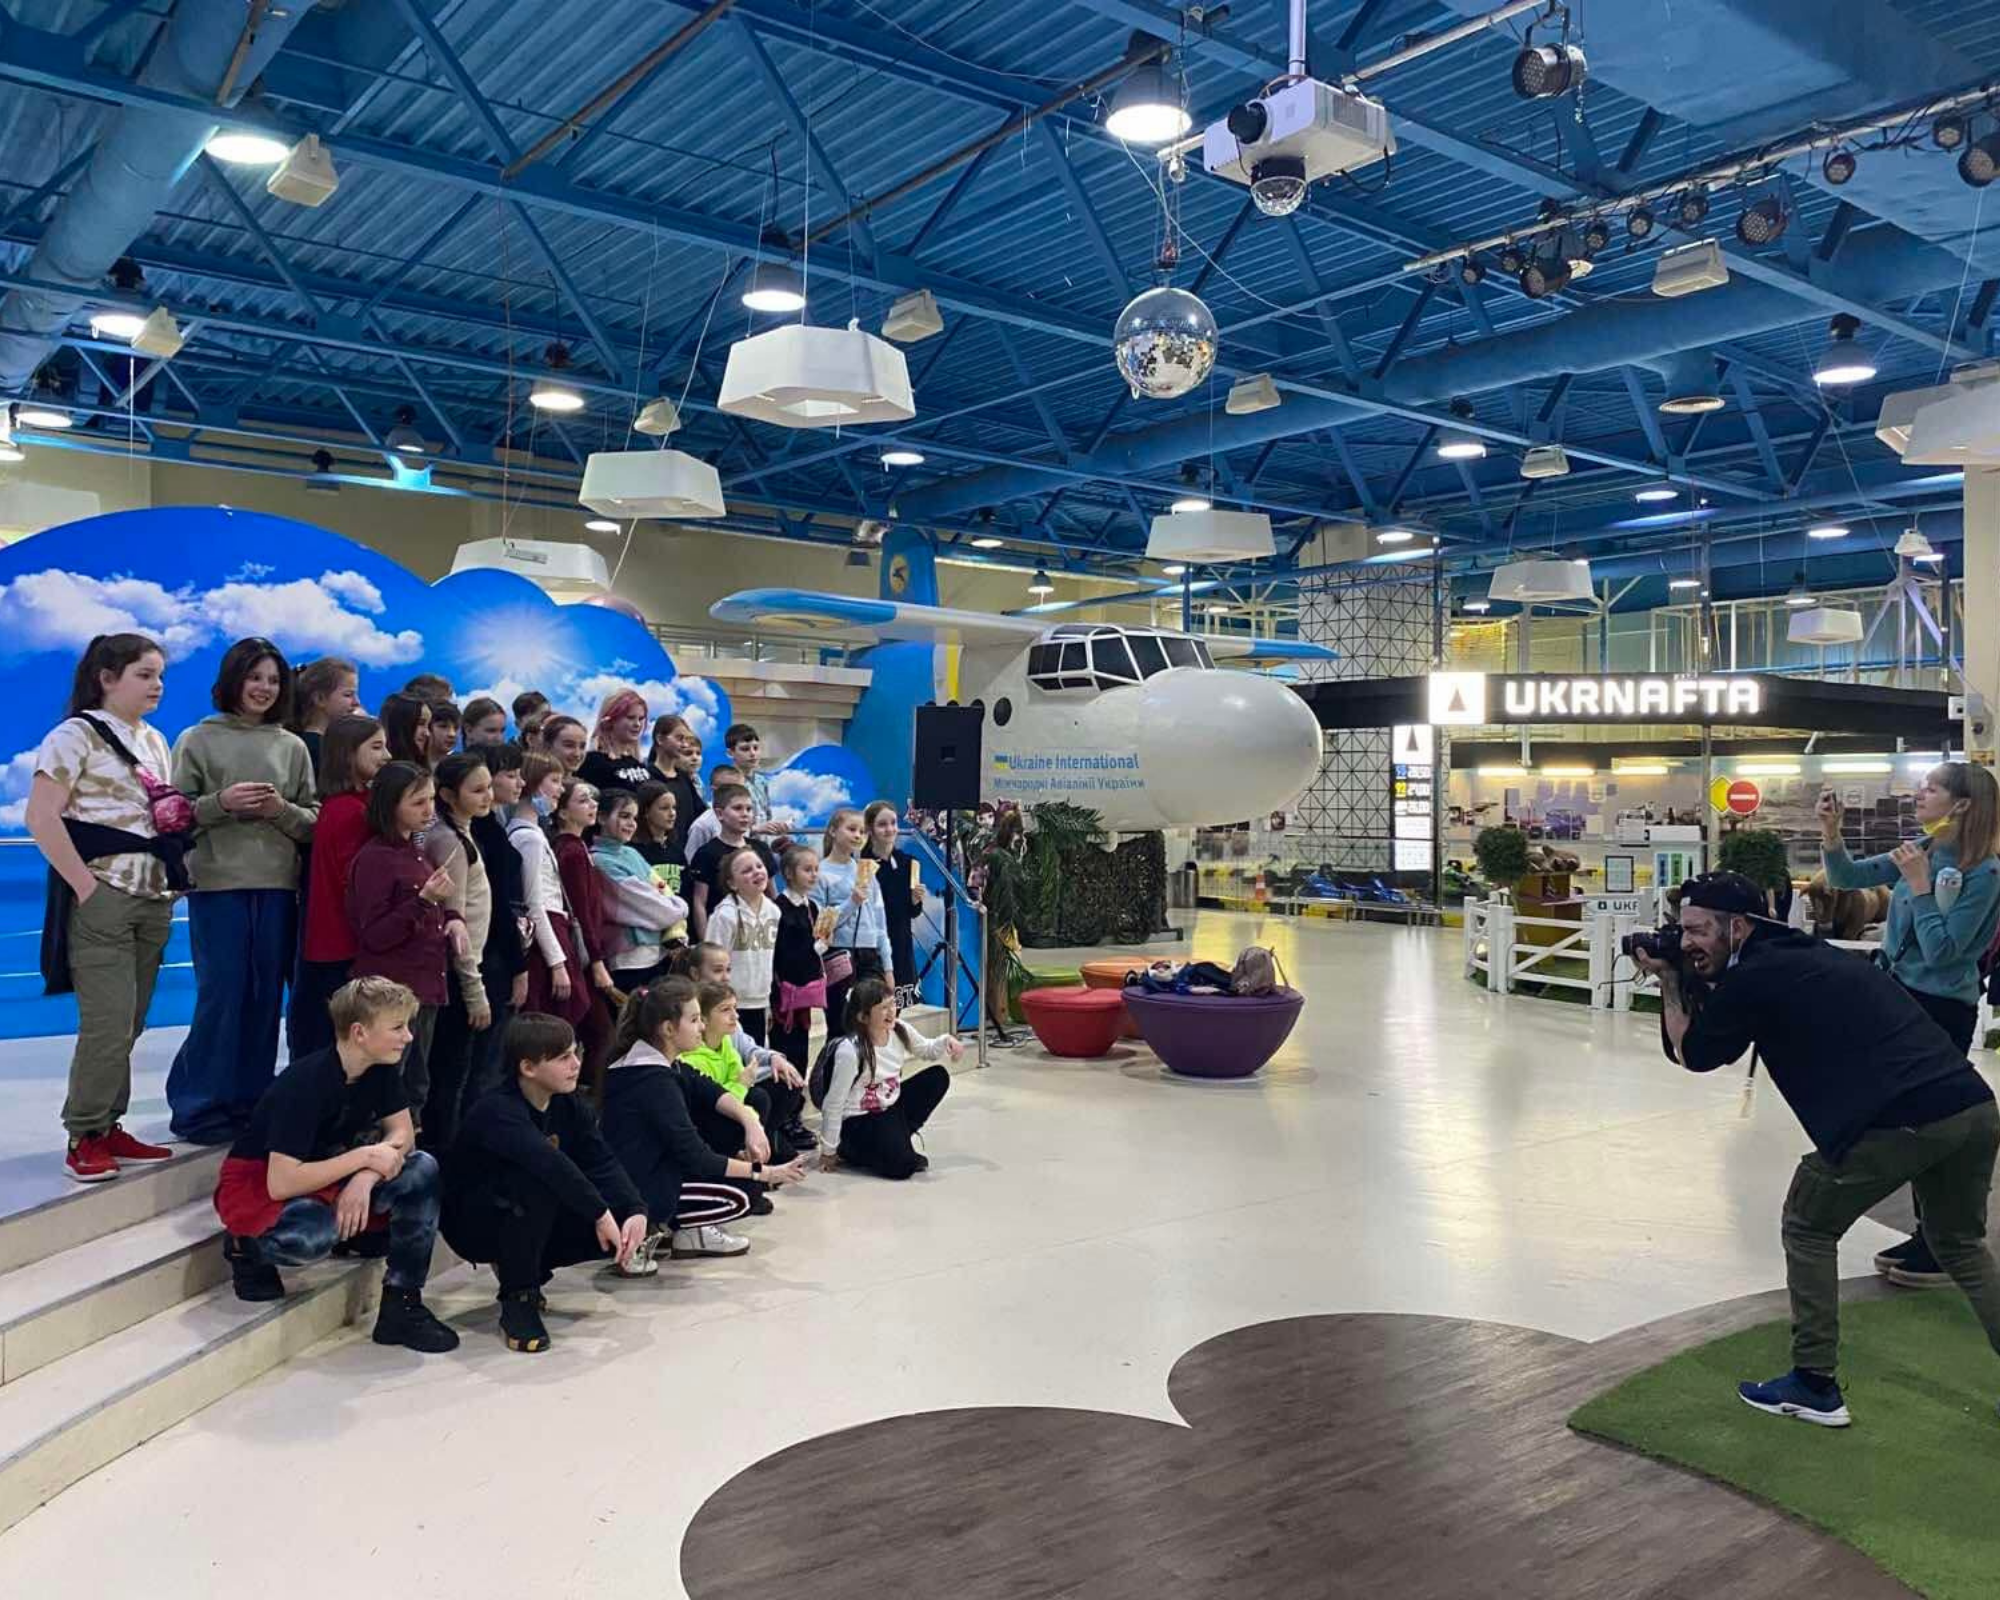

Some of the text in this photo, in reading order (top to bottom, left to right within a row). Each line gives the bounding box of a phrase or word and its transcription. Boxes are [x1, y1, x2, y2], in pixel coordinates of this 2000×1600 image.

[1504, 679, 1760, 714] UKRNAFTA
[1009, 752, 1139, 769] Ukraine International
